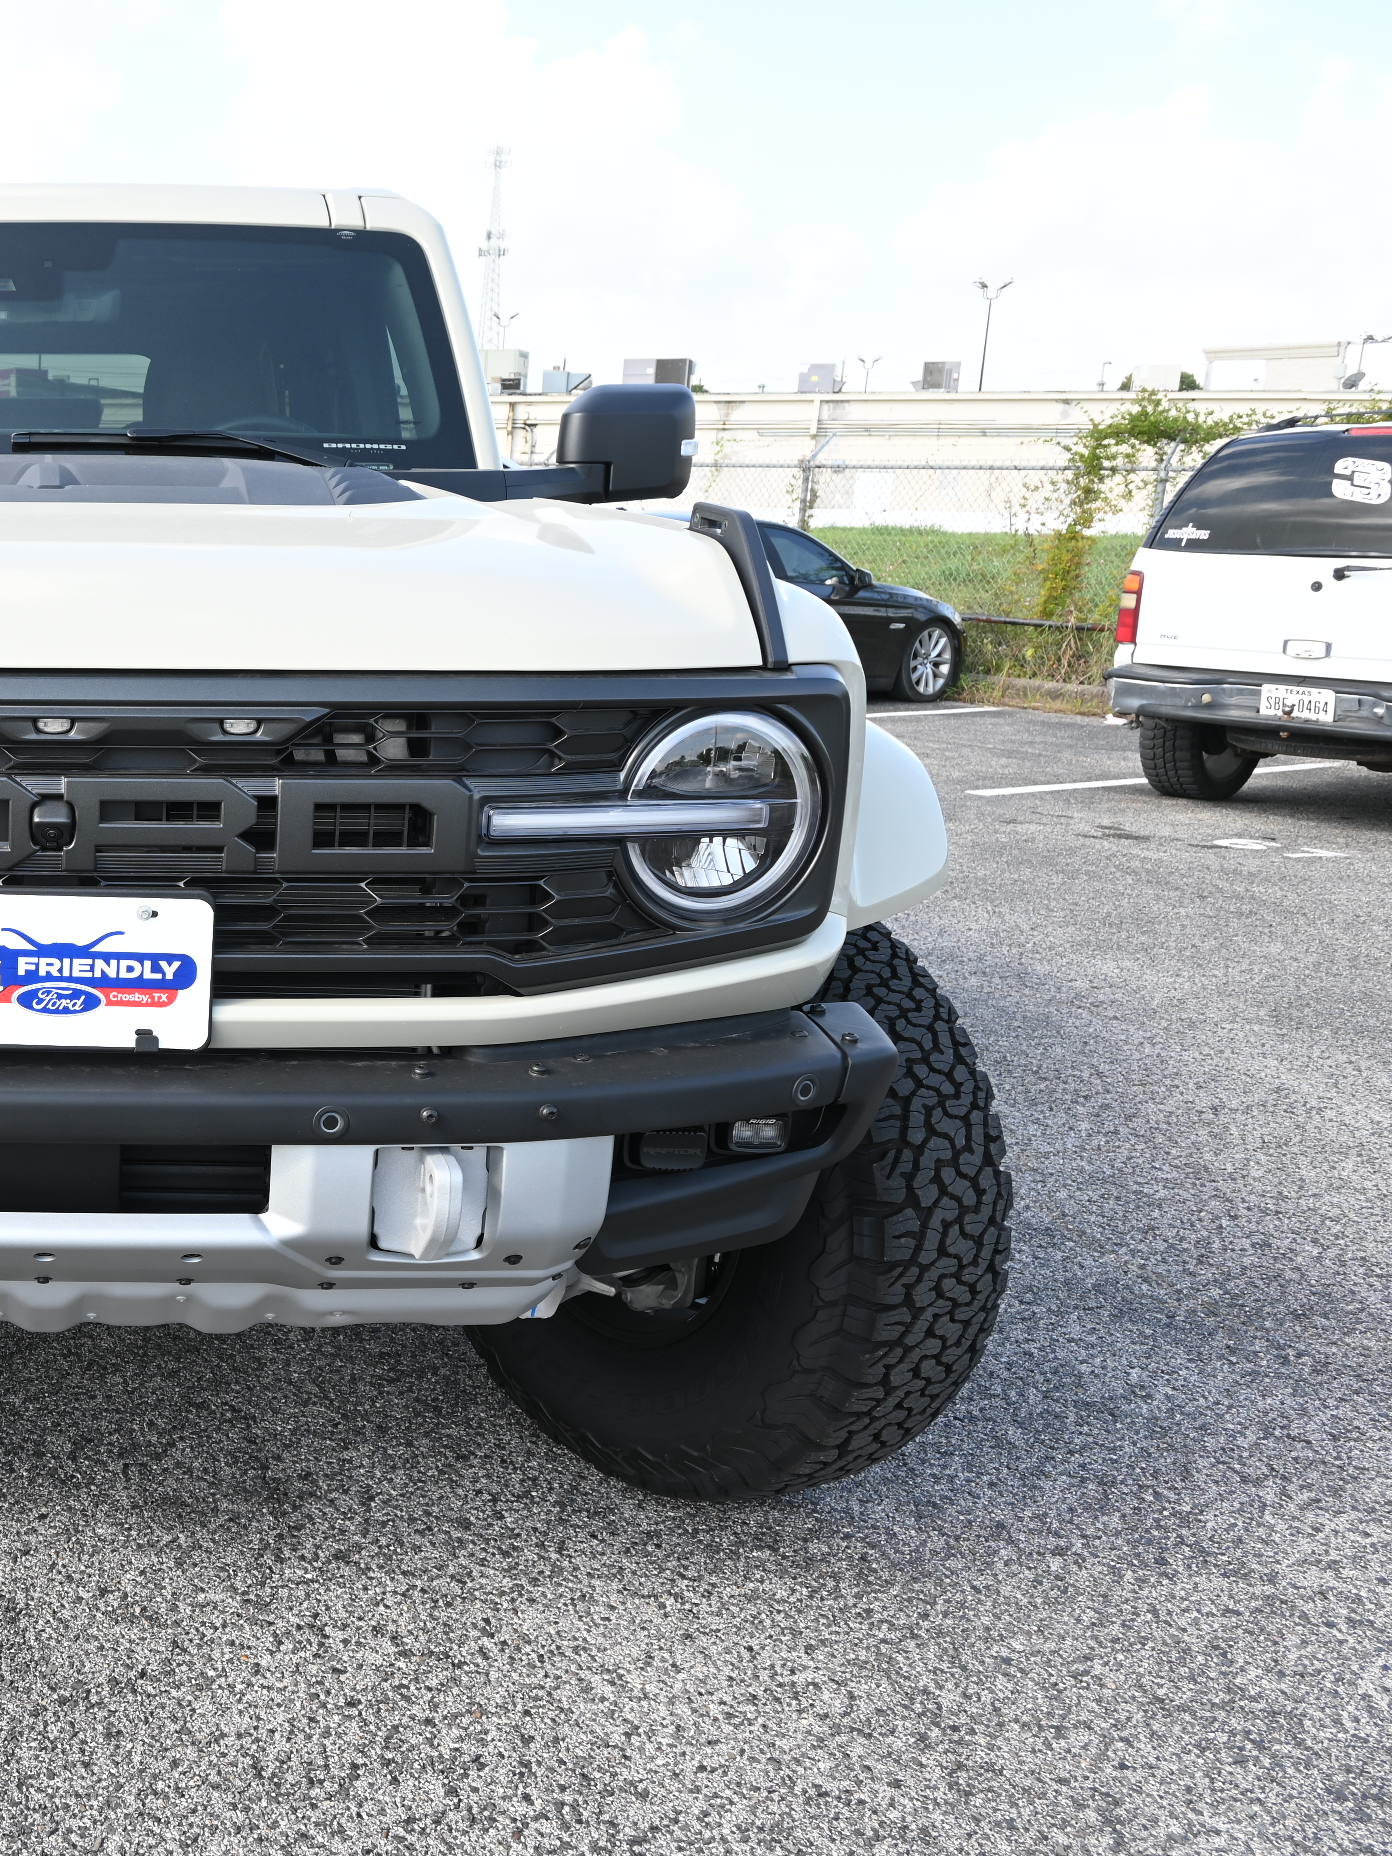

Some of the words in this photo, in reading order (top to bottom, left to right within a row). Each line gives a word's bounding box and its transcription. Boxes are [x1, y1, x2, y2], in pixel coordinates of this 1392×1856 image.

[1332, 456, 1392, 505] 3
[1285, 688, 1312, 697] TEXAS
[17, 956, 182, 980] FRIENDLY
[32, 988, 85, 1011] Ford
[109, 991, 151, 1004] Crosby,
[153, 992, 169, 1003] TX
